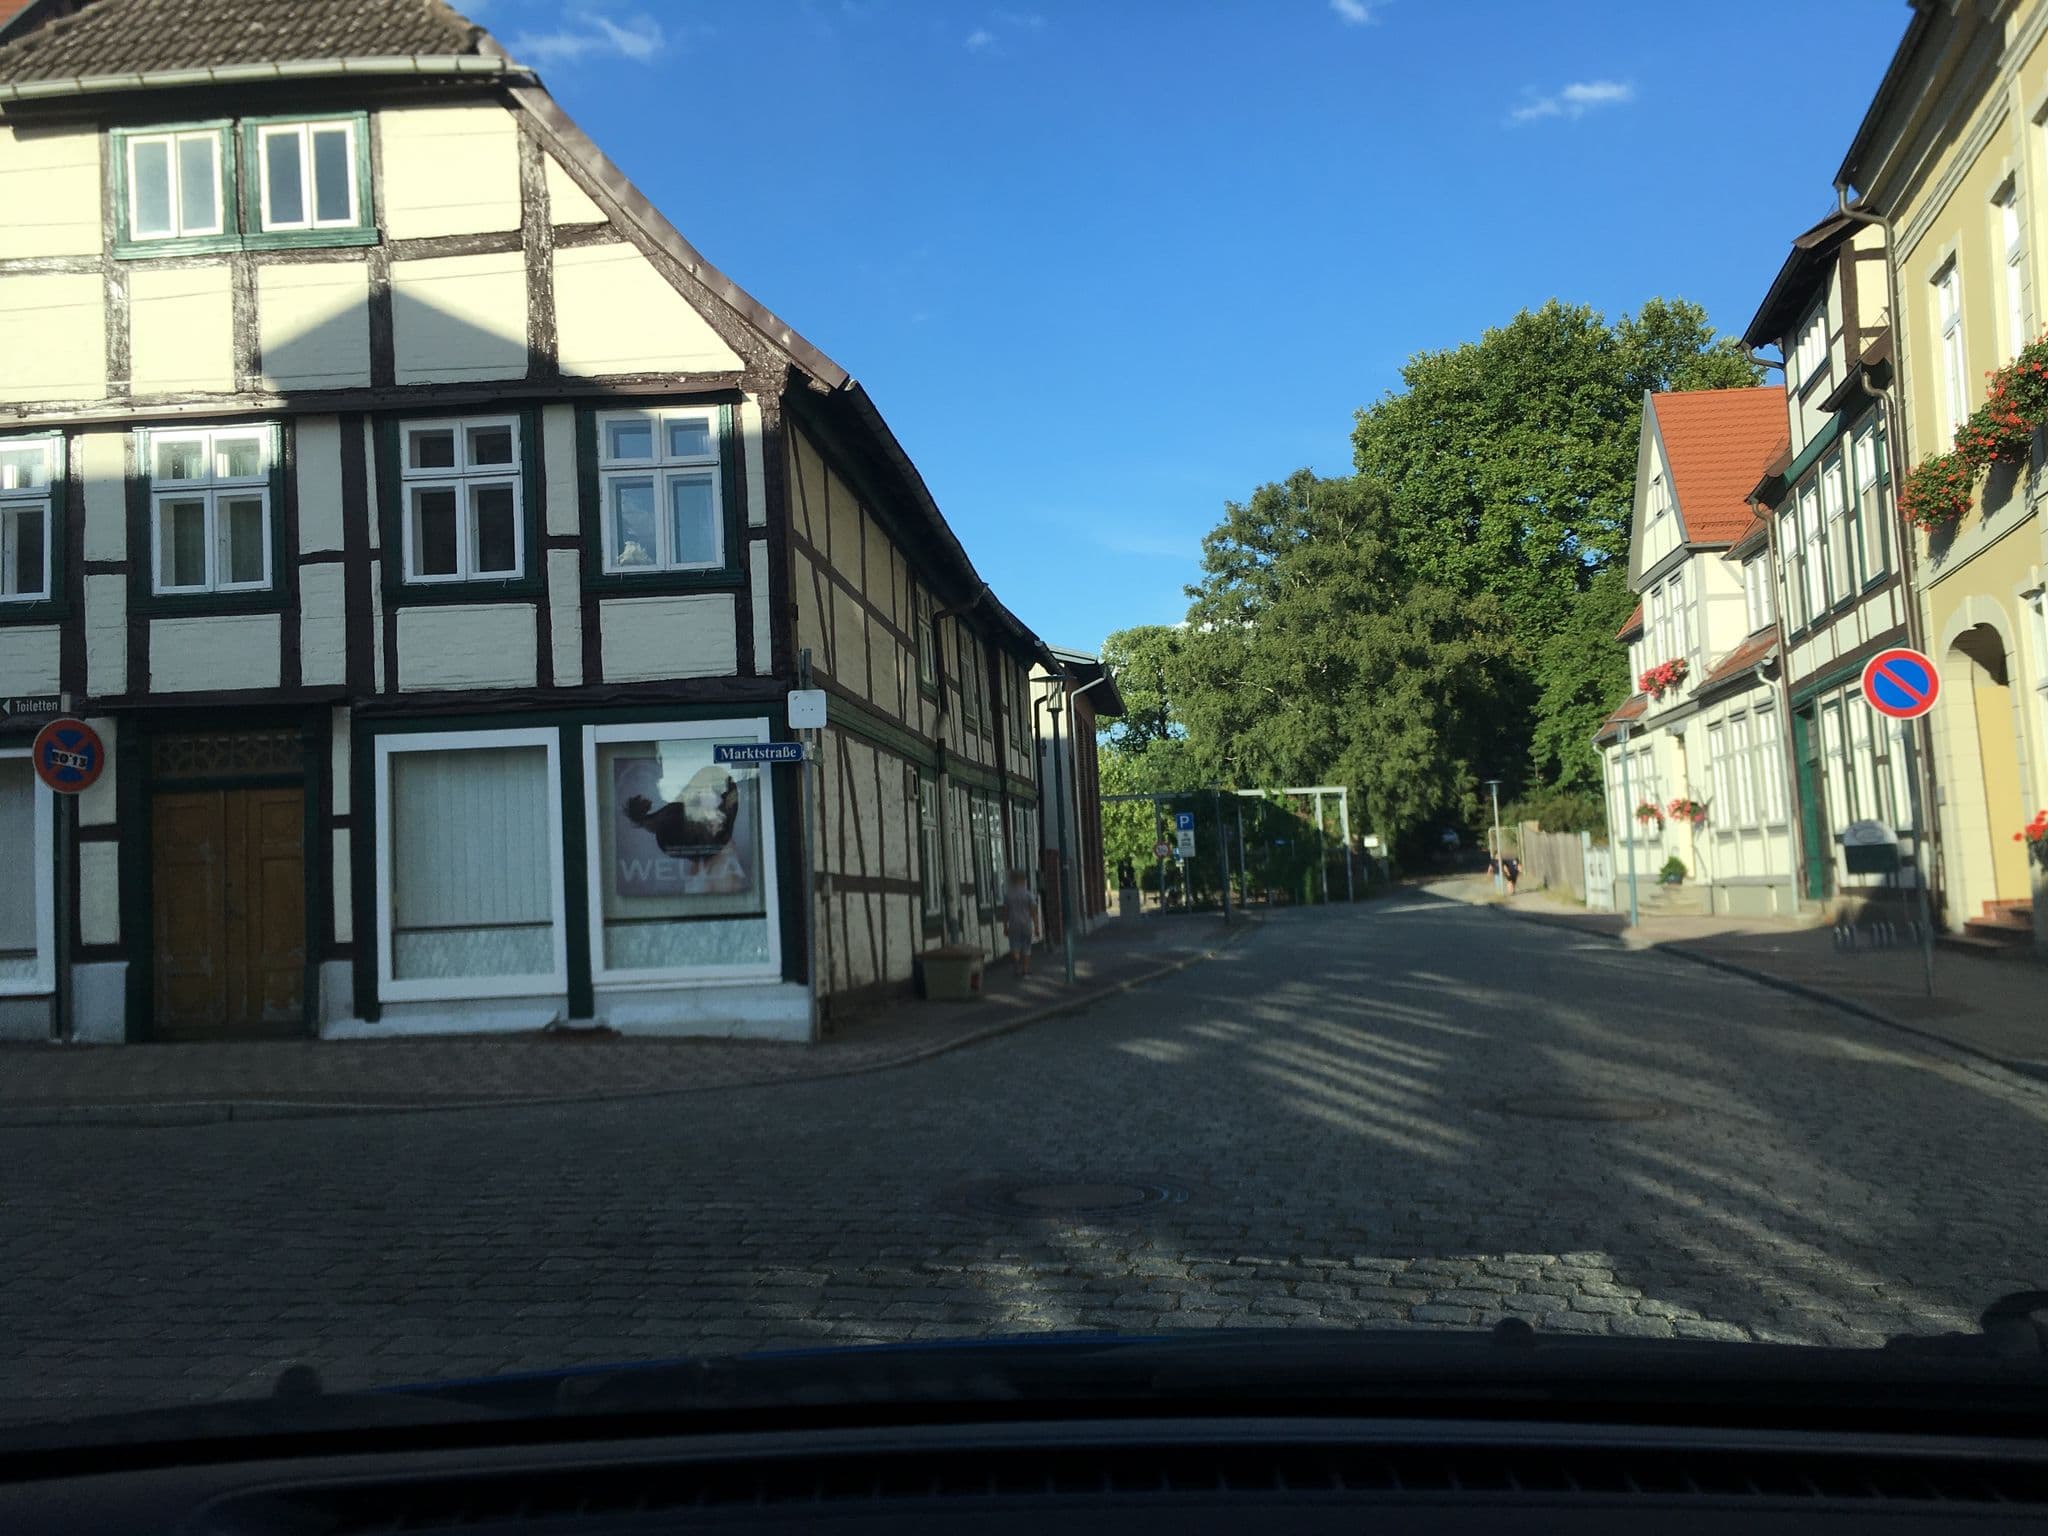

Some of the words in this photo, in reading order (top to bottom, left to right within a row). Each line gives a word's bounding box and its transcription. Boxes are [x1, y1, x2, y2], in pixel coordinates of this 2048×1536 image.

[15, 699, 58, 712] Toiletten
[721, 746, 797, 760] Marktstraße
[1180, 815, 1190, 829] P
